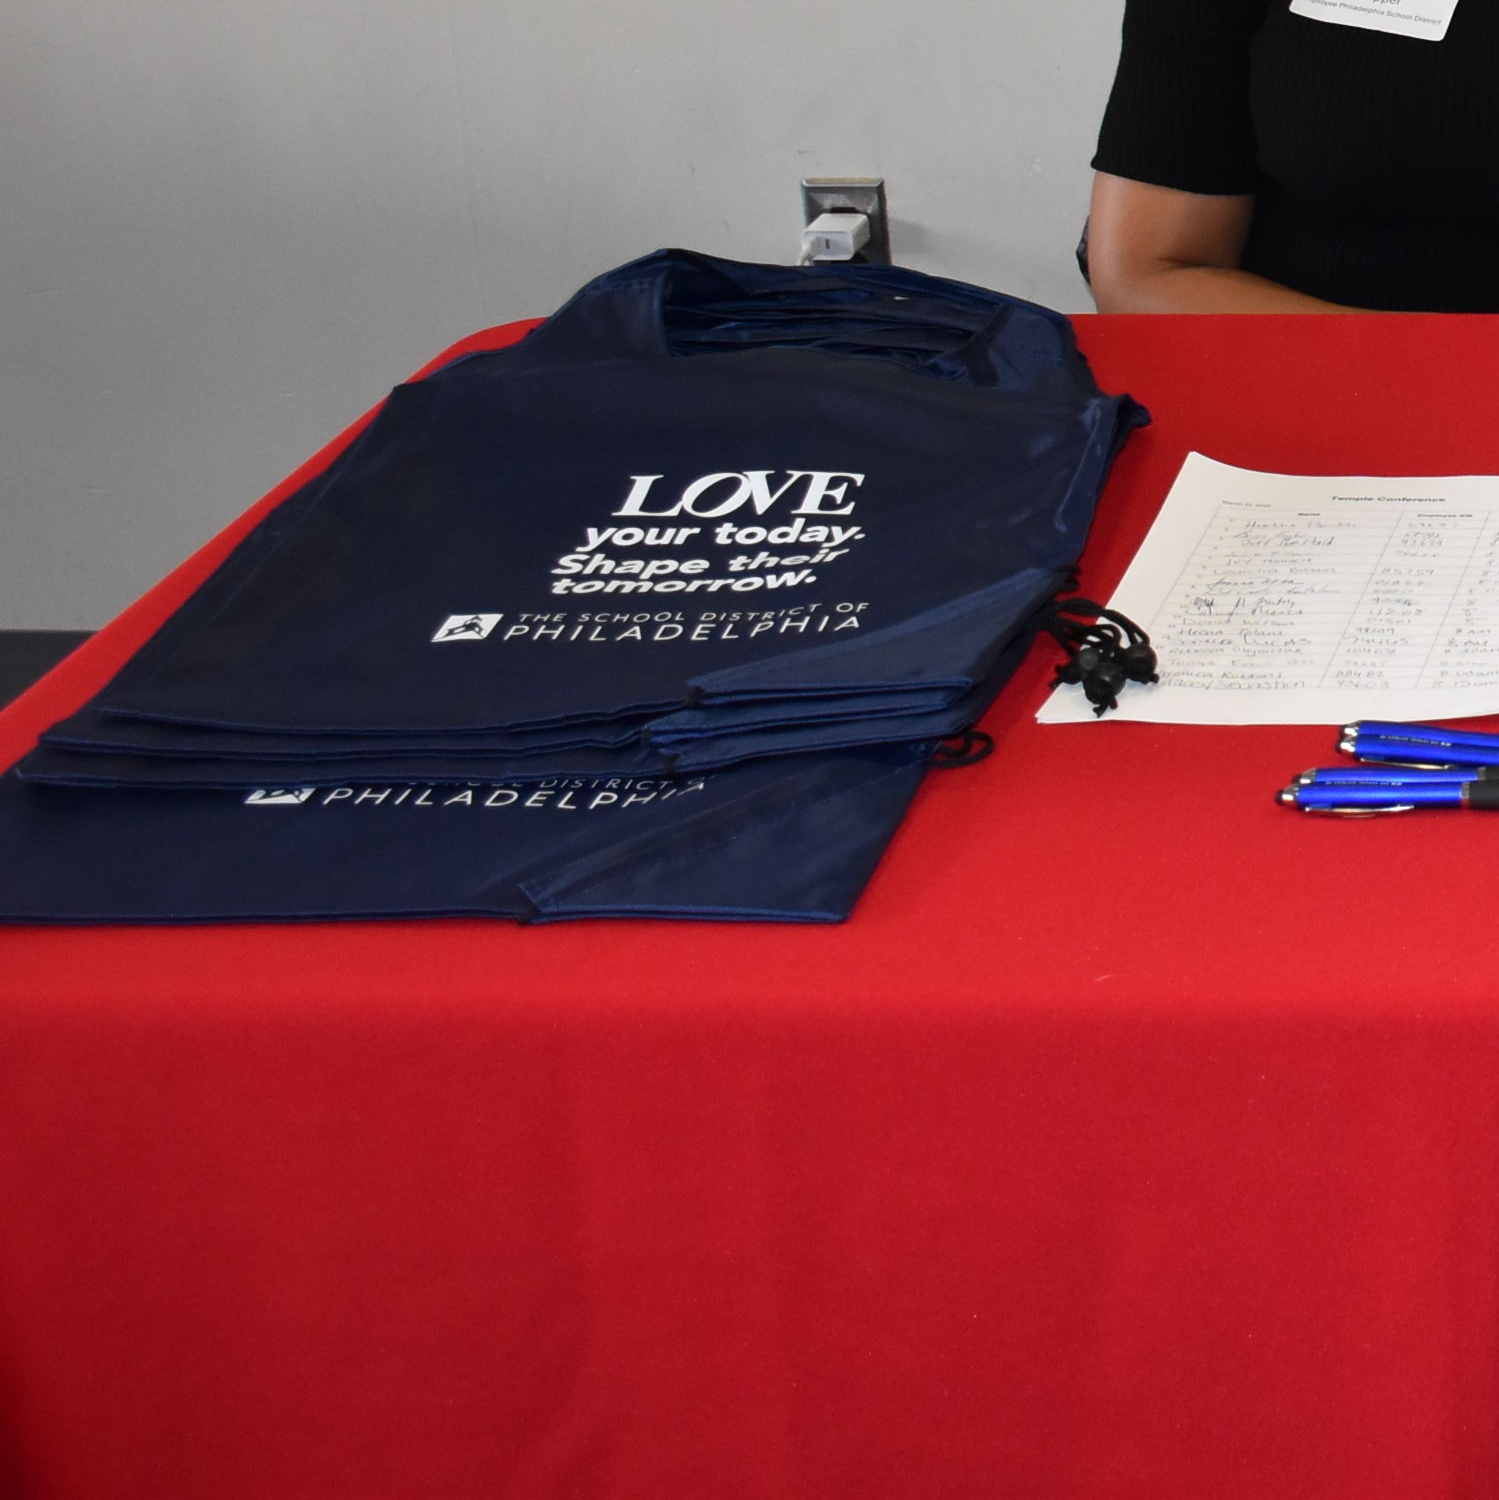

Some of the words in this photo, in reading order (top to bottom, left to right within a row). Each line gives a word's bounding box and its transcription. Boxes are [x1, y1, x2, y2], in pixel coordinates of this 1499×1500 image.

[1339, 2, 1385, 15] Philadelphia
[1387, 11, 1413, 20] School
[1414, 15, 1442, 25] District
[611, 469, 865, 517] LOVE
[576, 524, 701, 553] your
[713, 518, 867, 548] today.
[551, 554, 710, 579] Shape
[728, 547, 850, 573] their
[550, 570, 818, 595] tomorrow.
[519, 612, 567, 623] THE
[577, 611, 685, 624] SCHOOL
[699, 603, 821, 622] DISTRICT
[836, 602, 870, 613] OF
[503, 614, 860, 642] PHILADELPHIA
[322, 782, 705, 810] PHILADELPHIA
